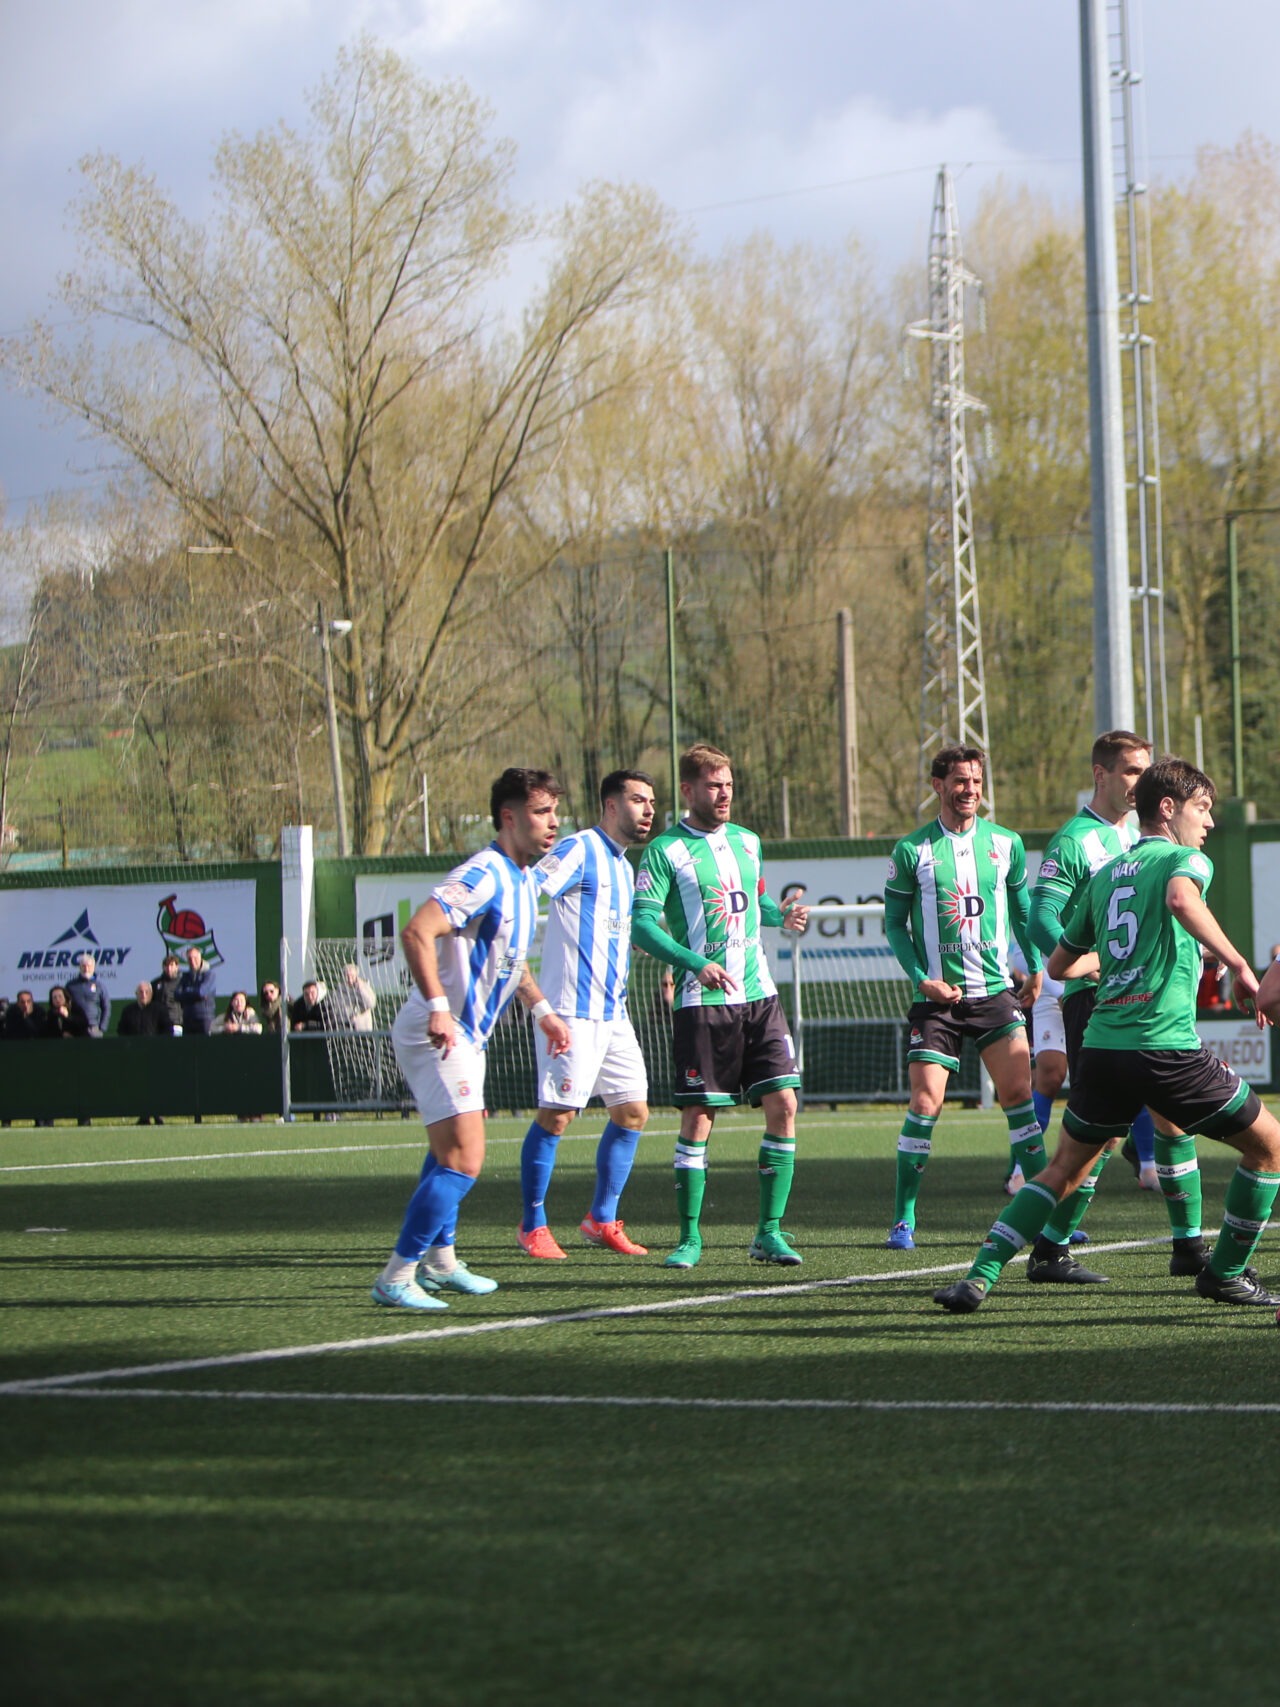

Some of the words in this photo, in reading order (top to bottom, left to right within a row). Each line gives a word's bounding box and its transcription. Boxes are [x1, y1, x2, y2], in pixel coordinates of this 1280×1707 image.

[729, 890, 748, 914] D
[963, 896, 984, 917] D
[1107, 886, 1138, 961] 5
[17, 947, 131, 969] MERCURY
[1201, 1039, 1265, 1065] ENEDO
